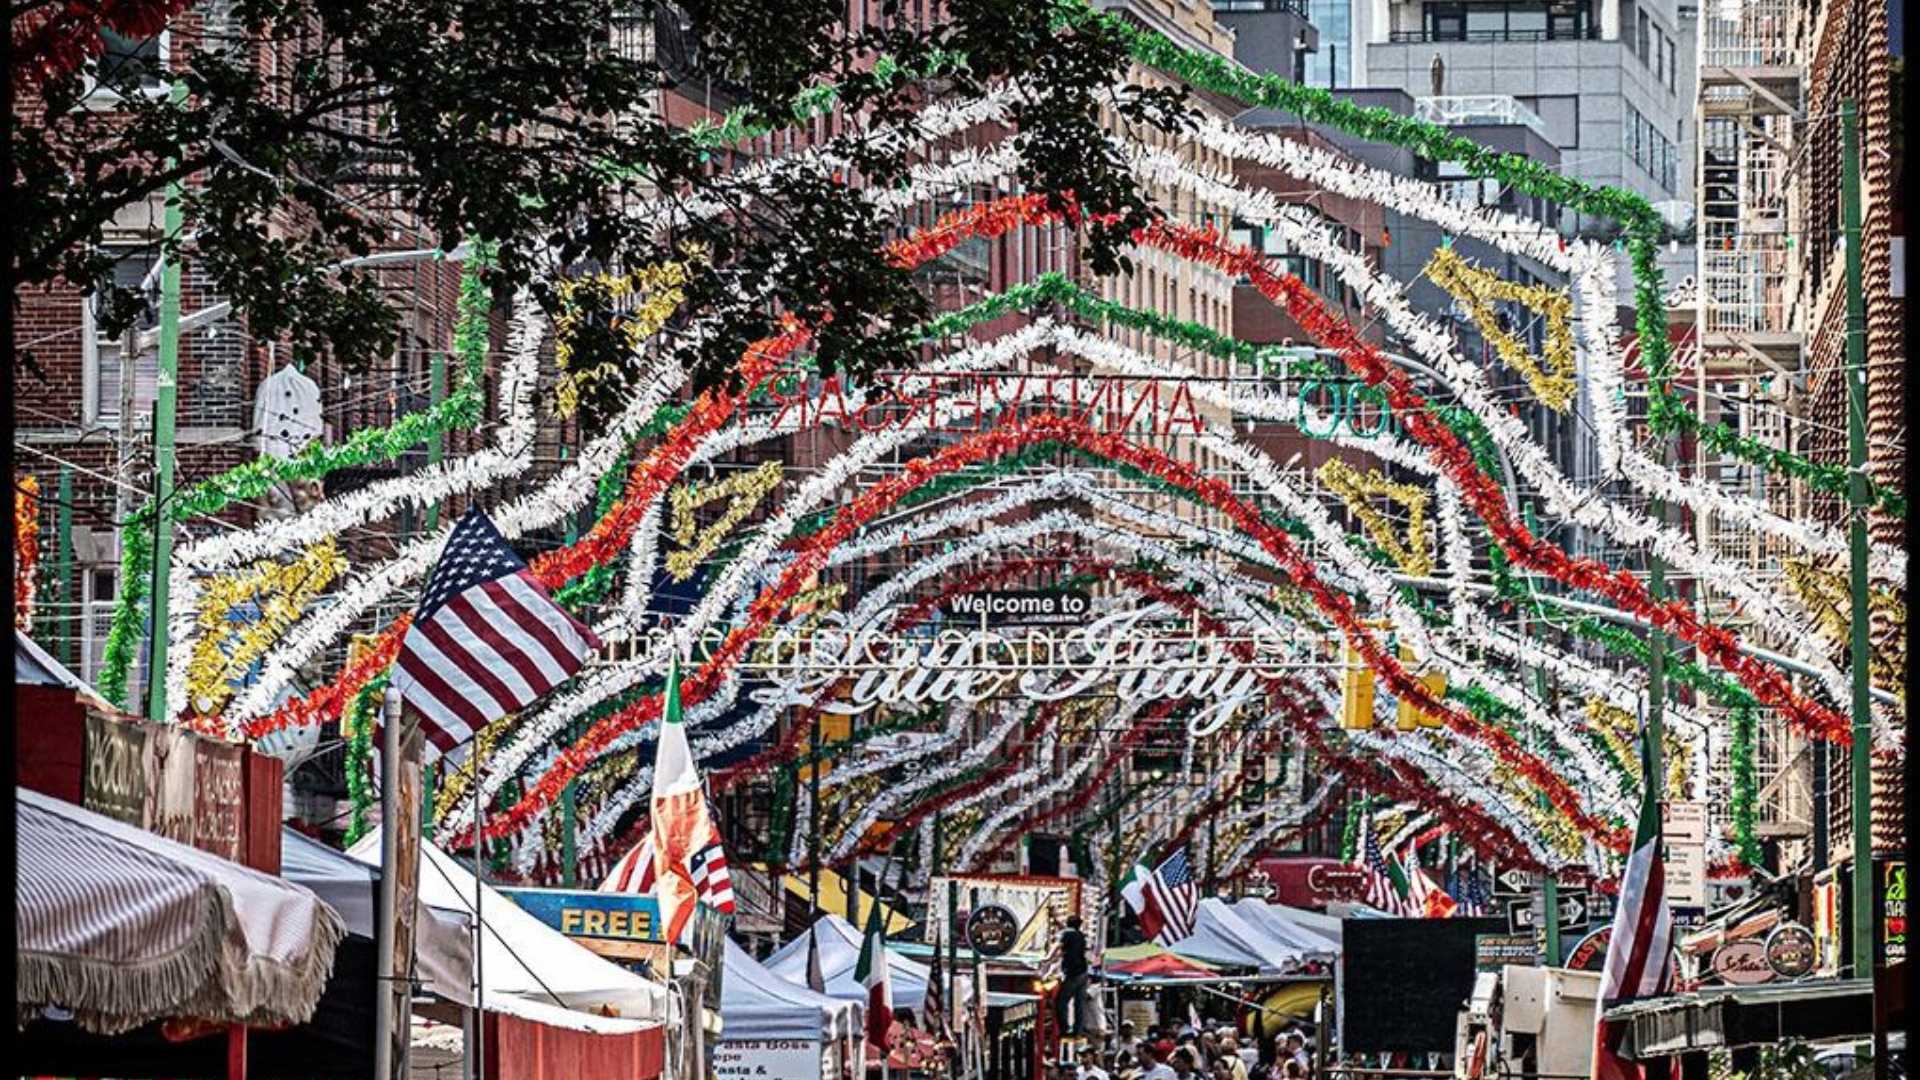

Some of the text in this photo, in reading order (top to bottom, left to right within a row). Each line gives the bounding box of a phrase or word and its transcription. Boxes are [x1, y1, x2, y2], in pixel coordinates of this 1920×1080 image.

[951, 593, 1084, 614] Welcome to
[750, 606, 1012, 715] Little
[1019, 602, 1272, 737] Italy
[1509, 871, 1533, 888] ON
[561, 908, 651, 939] FREE
[717, 1040, 760, 1050] asta
